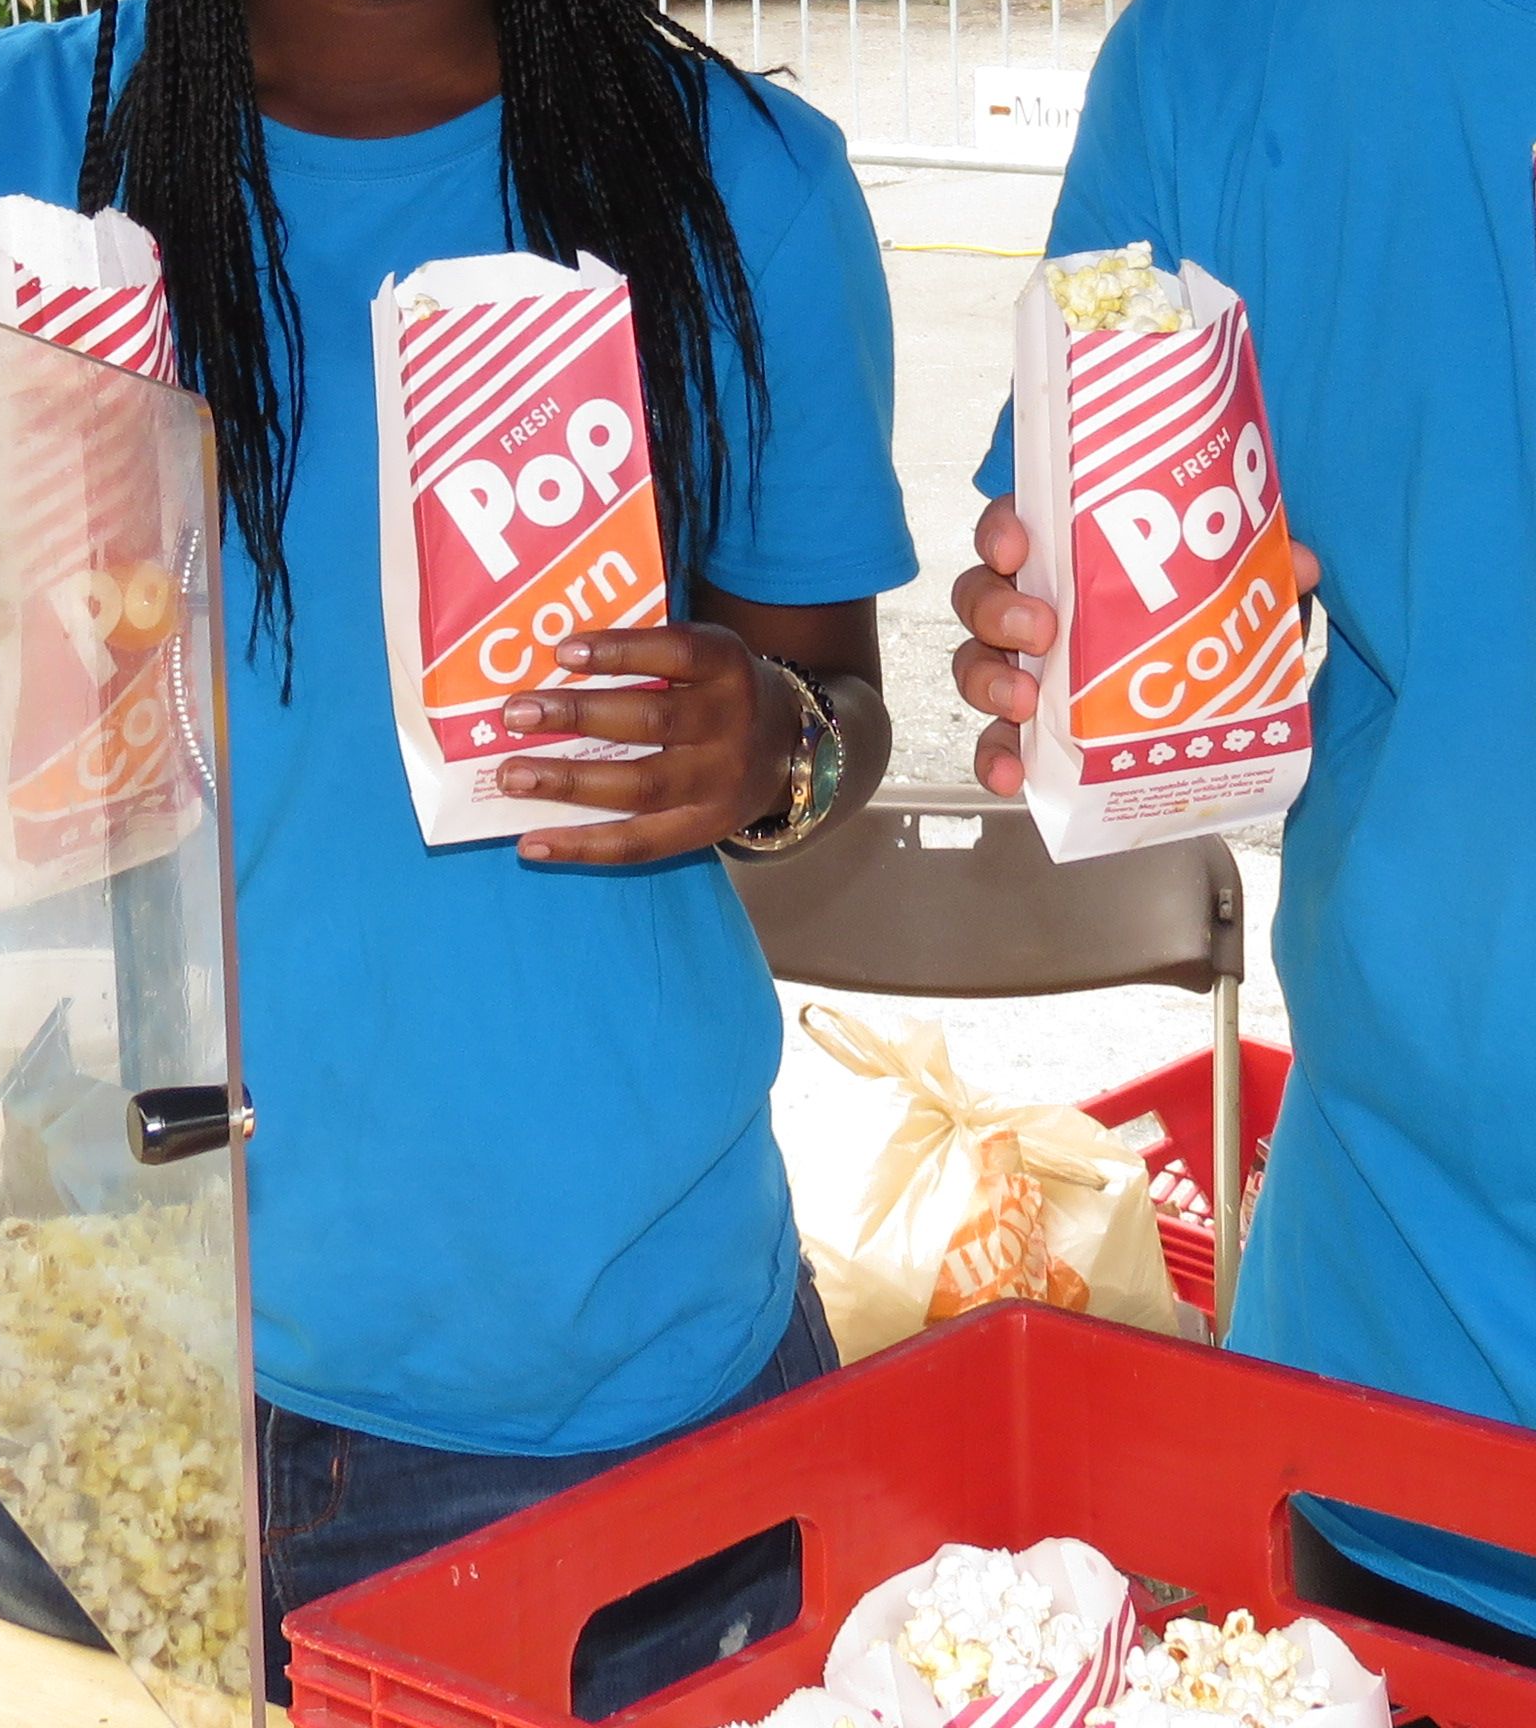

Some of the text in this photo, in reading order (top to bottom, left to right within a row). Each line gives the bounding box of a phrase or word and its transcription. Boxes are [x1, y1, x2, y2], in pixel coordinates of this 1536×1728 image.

[499, 397, 561, 454] FRESH
[1170, 427, 1231, 487] FRESH
[47, 560, 168, 687] Po
[479, 550, 638, 684] Corn
[1128, 577, 1276, 719] Corn
